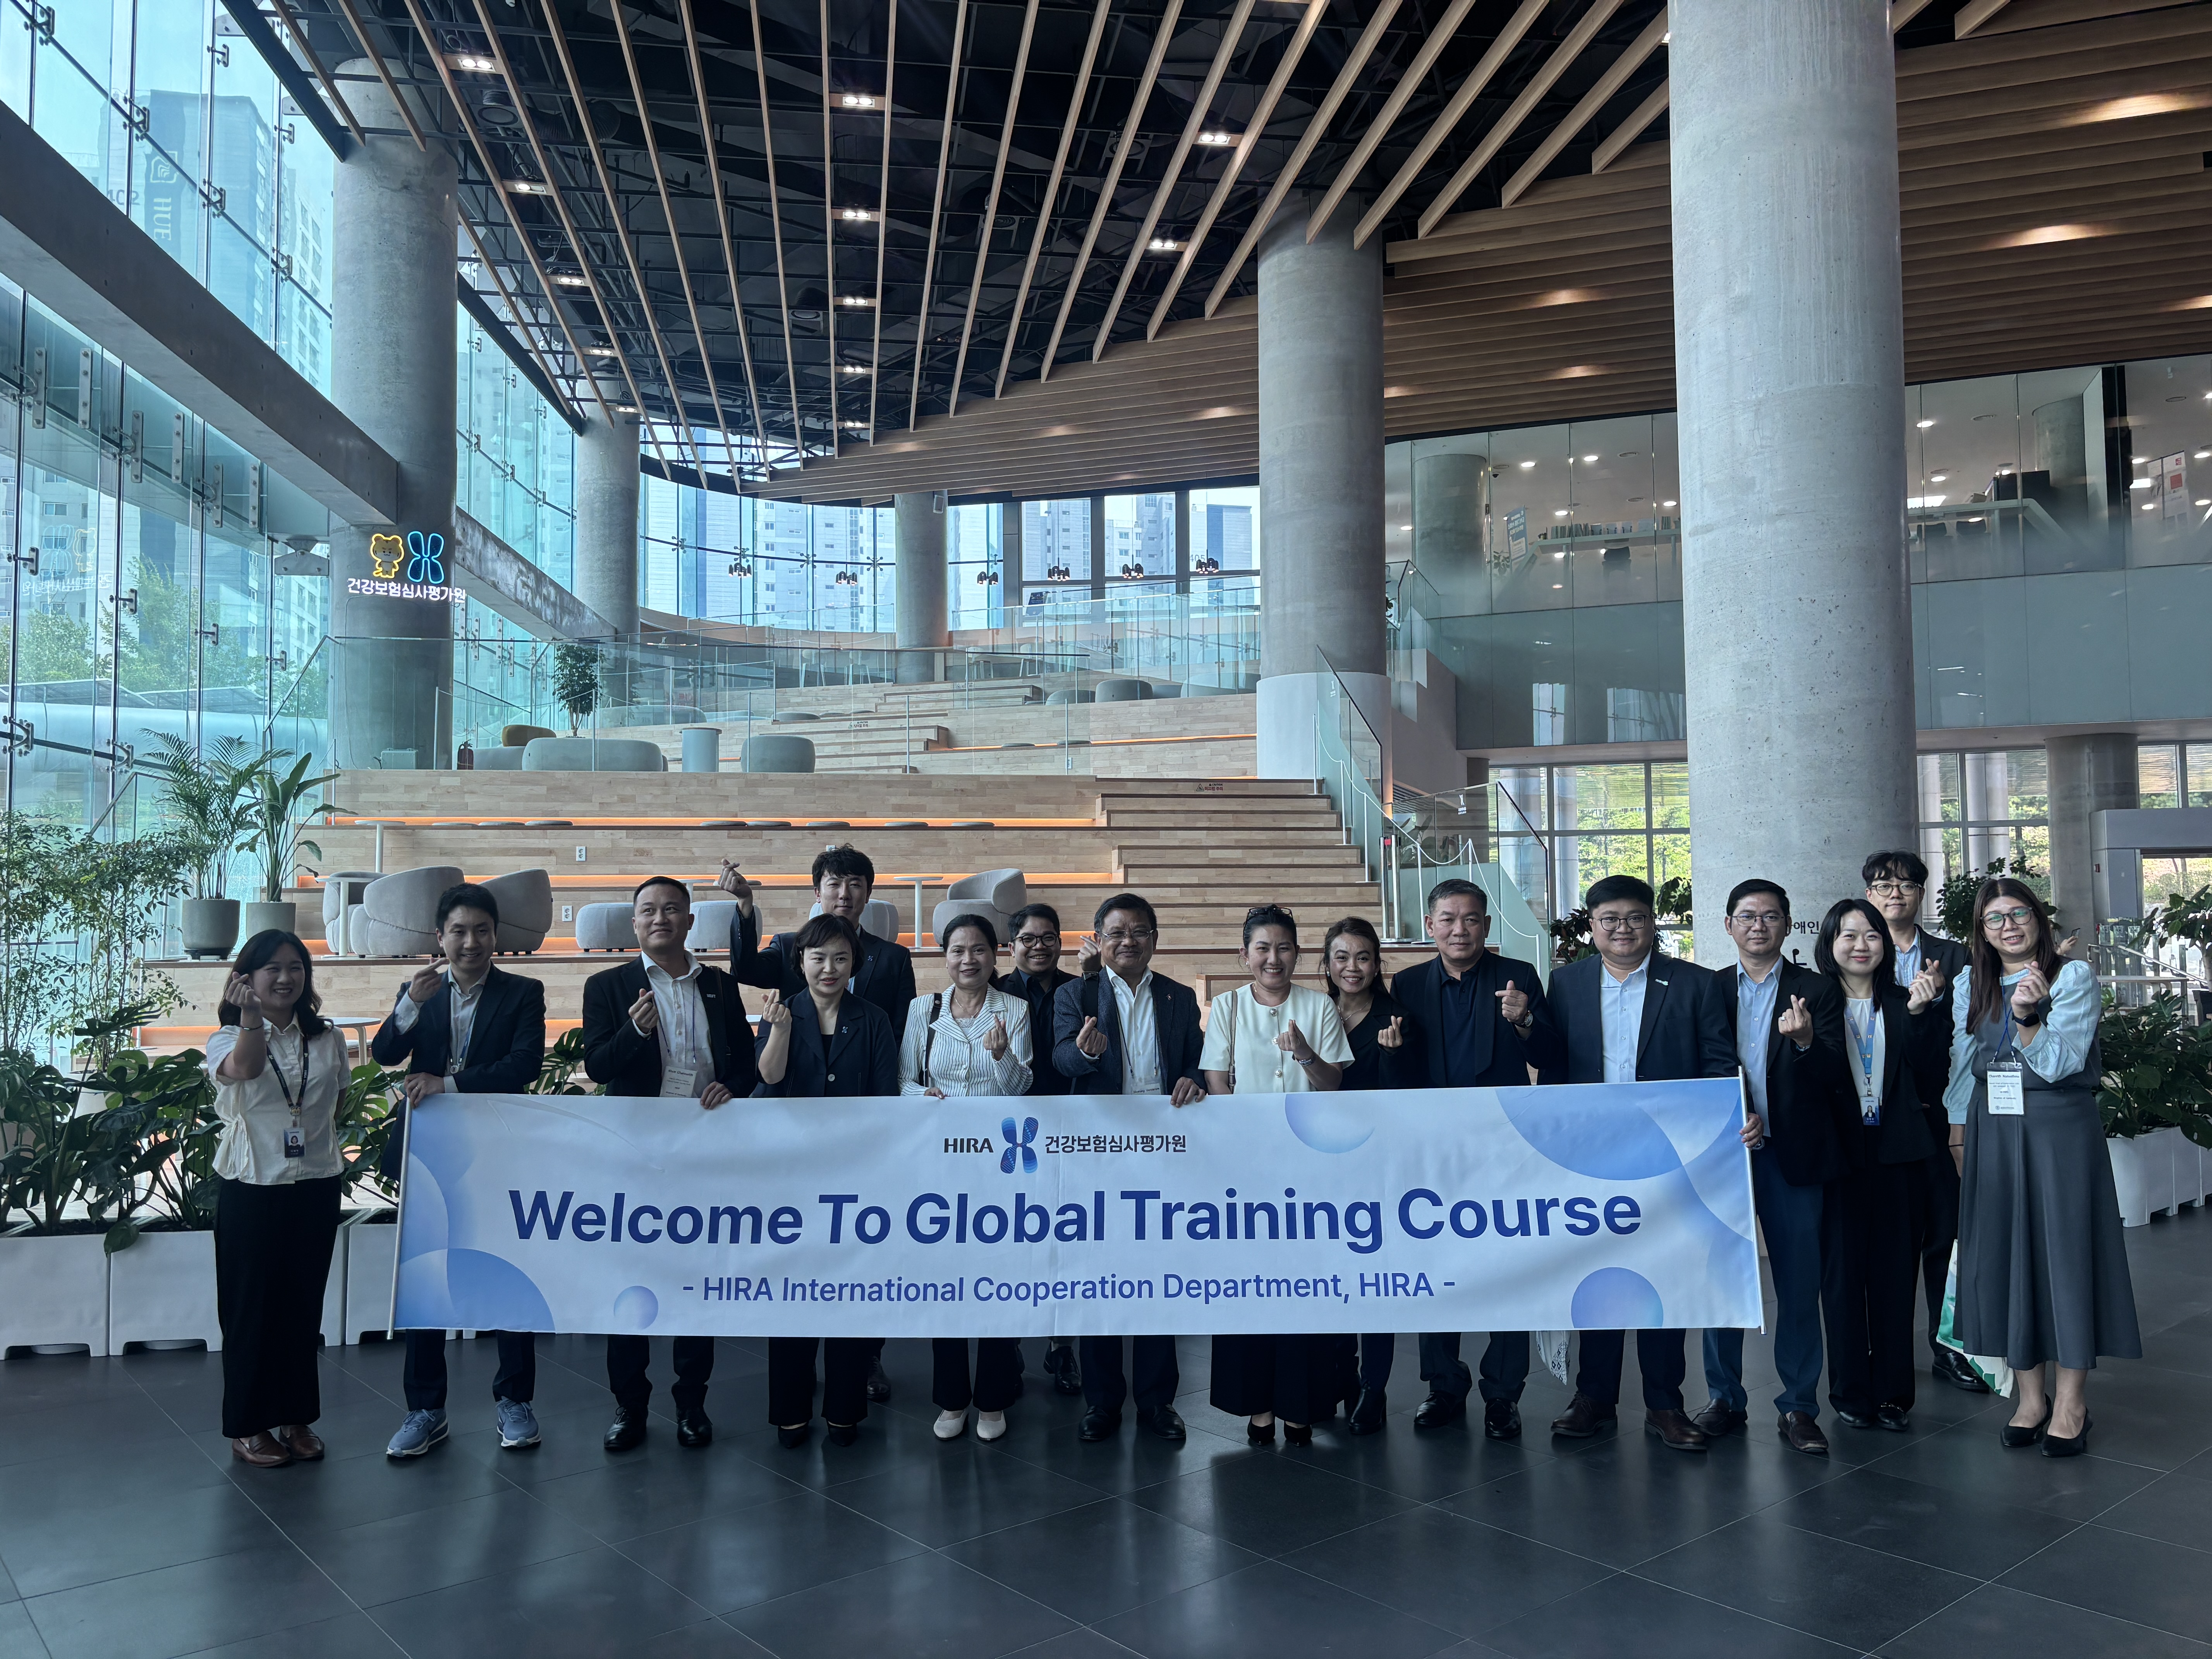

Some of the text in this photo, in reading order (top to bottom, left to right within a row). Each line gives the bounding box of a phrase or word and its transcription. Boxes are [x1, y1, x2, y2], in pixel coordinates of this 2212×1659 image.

[153, 198, 172, 241] HUE
[347, 578, 465, 603] 건강보험심사평가원
[1791, 921, 1819, 934] 애인
[944, 1138, 994, 1153] HIRA
[1045, 1135, 1186, 1154] 건강보험심사평가원
[508, 1187, 1642, 1254] Welcome To Global Training Course
[704, 1277, 774, 1301] HIRA
[783, 1276, 964, 1302] International
[974, 1273, 1154, 1307] Cooperation
[1164, 1274, 1349, 1305] Department,
[1359, 1272, 1434, 1297] HIRA
